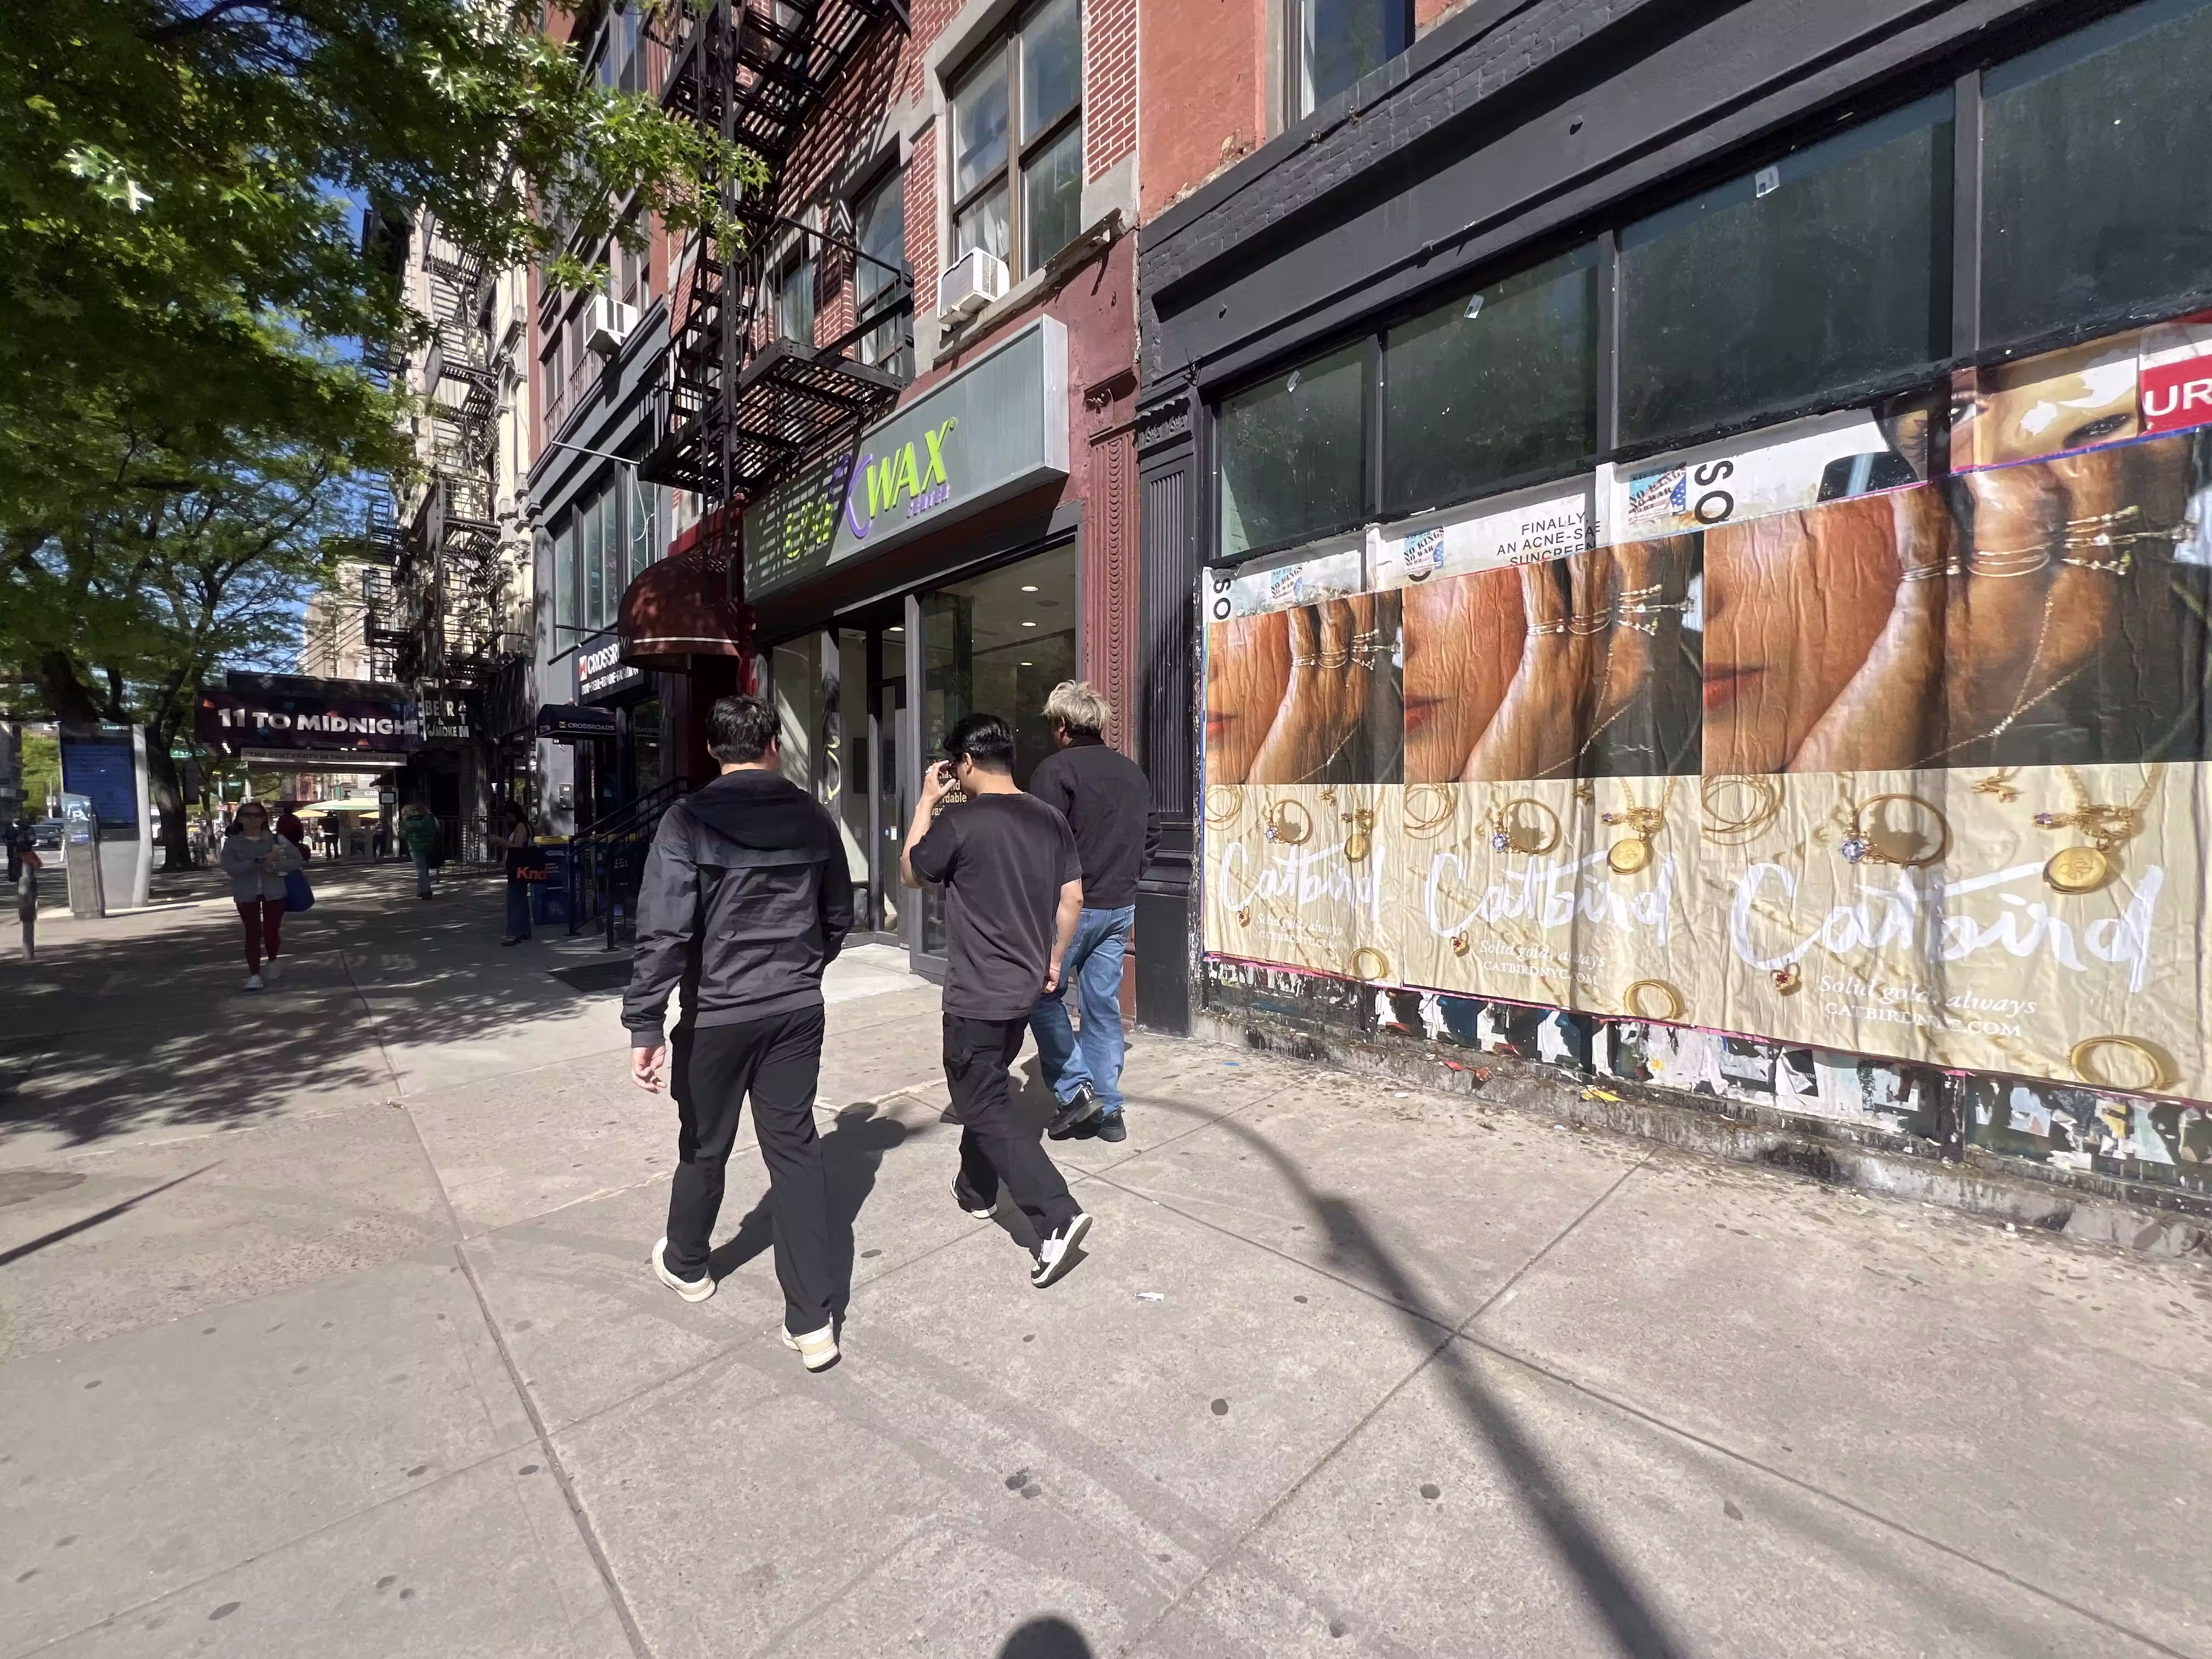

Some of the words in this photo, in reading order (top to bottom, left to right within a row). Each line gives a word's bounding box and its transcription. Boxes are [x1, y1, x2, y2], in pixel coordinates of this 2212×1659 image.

[866, 420, 950, 520] WAX
[906, 483, 950, 519] CENTER
[1629, 490, 1645, 501] NO
[1404, 547, 1415, 557] NO
[1417, 529, 1444, 549] KINGS
[1417, 545, 1434, 557] WAR
[1497, 541, 1516, 556] AN
[1271, 582, 1279, 591] NO
[587, 642, 619, 675] CROSSR
[218, 708, 246, 727] 11
[252, 712, 291, 729] TO
[425, 700, 454, 716] BER
[427, 722, 458, 737] SMOKE
[567, 723, 614, 731] CROSSROADS
[1220, 842, 1386, 922] Catbird
[1424, 850, 1677, 947] Catbird
[1257, 913, 1280, 927] Solid
[1308, 920, 1342, 938] always
[1730, 862, 2165, 994] Catbird
[1479, 940, 1515, 956] Solid
[1516, 943, 1553, 961] gold,
[1483, 960, 1598, 985] CATBIRDNYC.COM
[1819, 975, 1877, 997] Solid
[1945, 989, 2038, 1018] always
